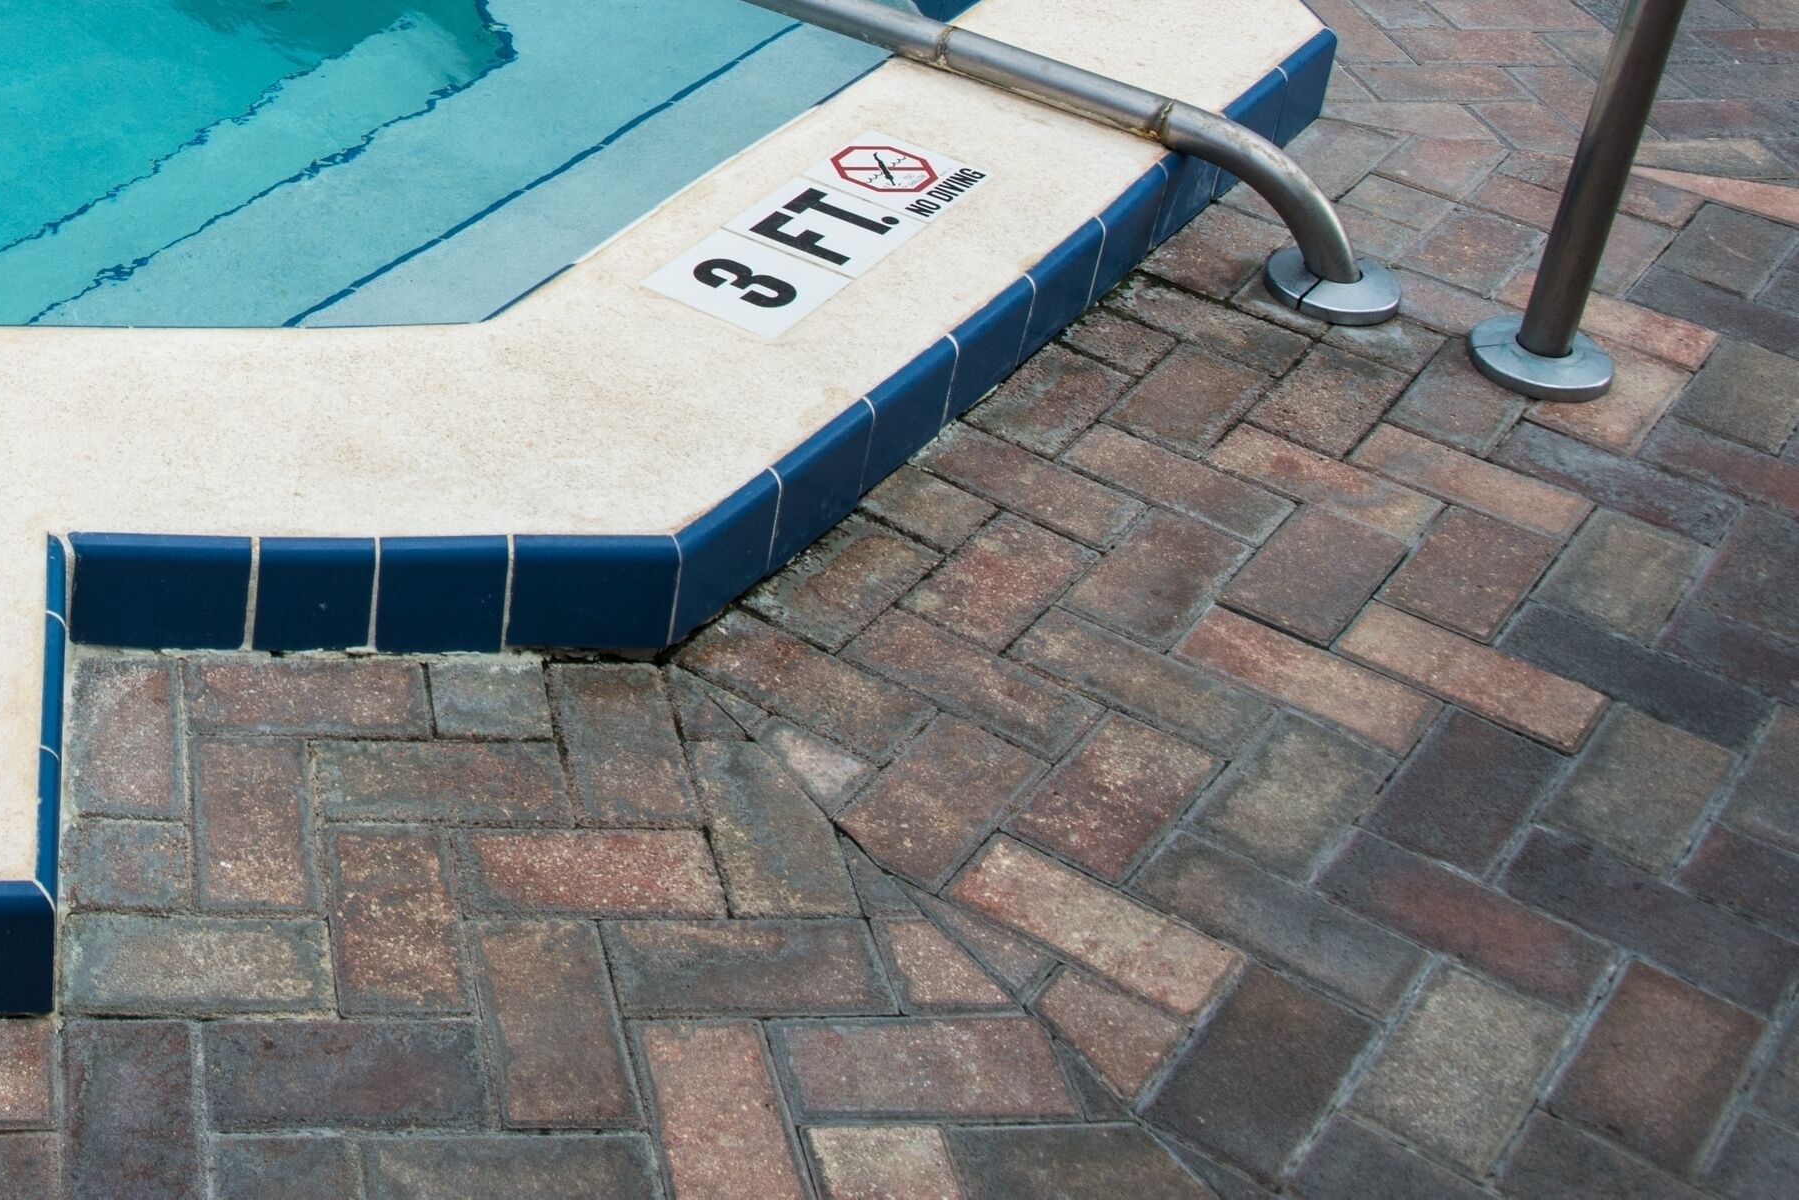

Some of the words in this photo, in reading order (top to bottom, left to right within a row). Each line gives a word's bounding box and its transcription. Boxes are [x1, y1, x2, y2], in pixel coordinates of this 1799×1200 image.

[905, 199, 941, 217] NO
[926, 168, 987, 202] DIVING
[693, 258, 797, 309] 3
[749, 187, 900, 266] FT.
